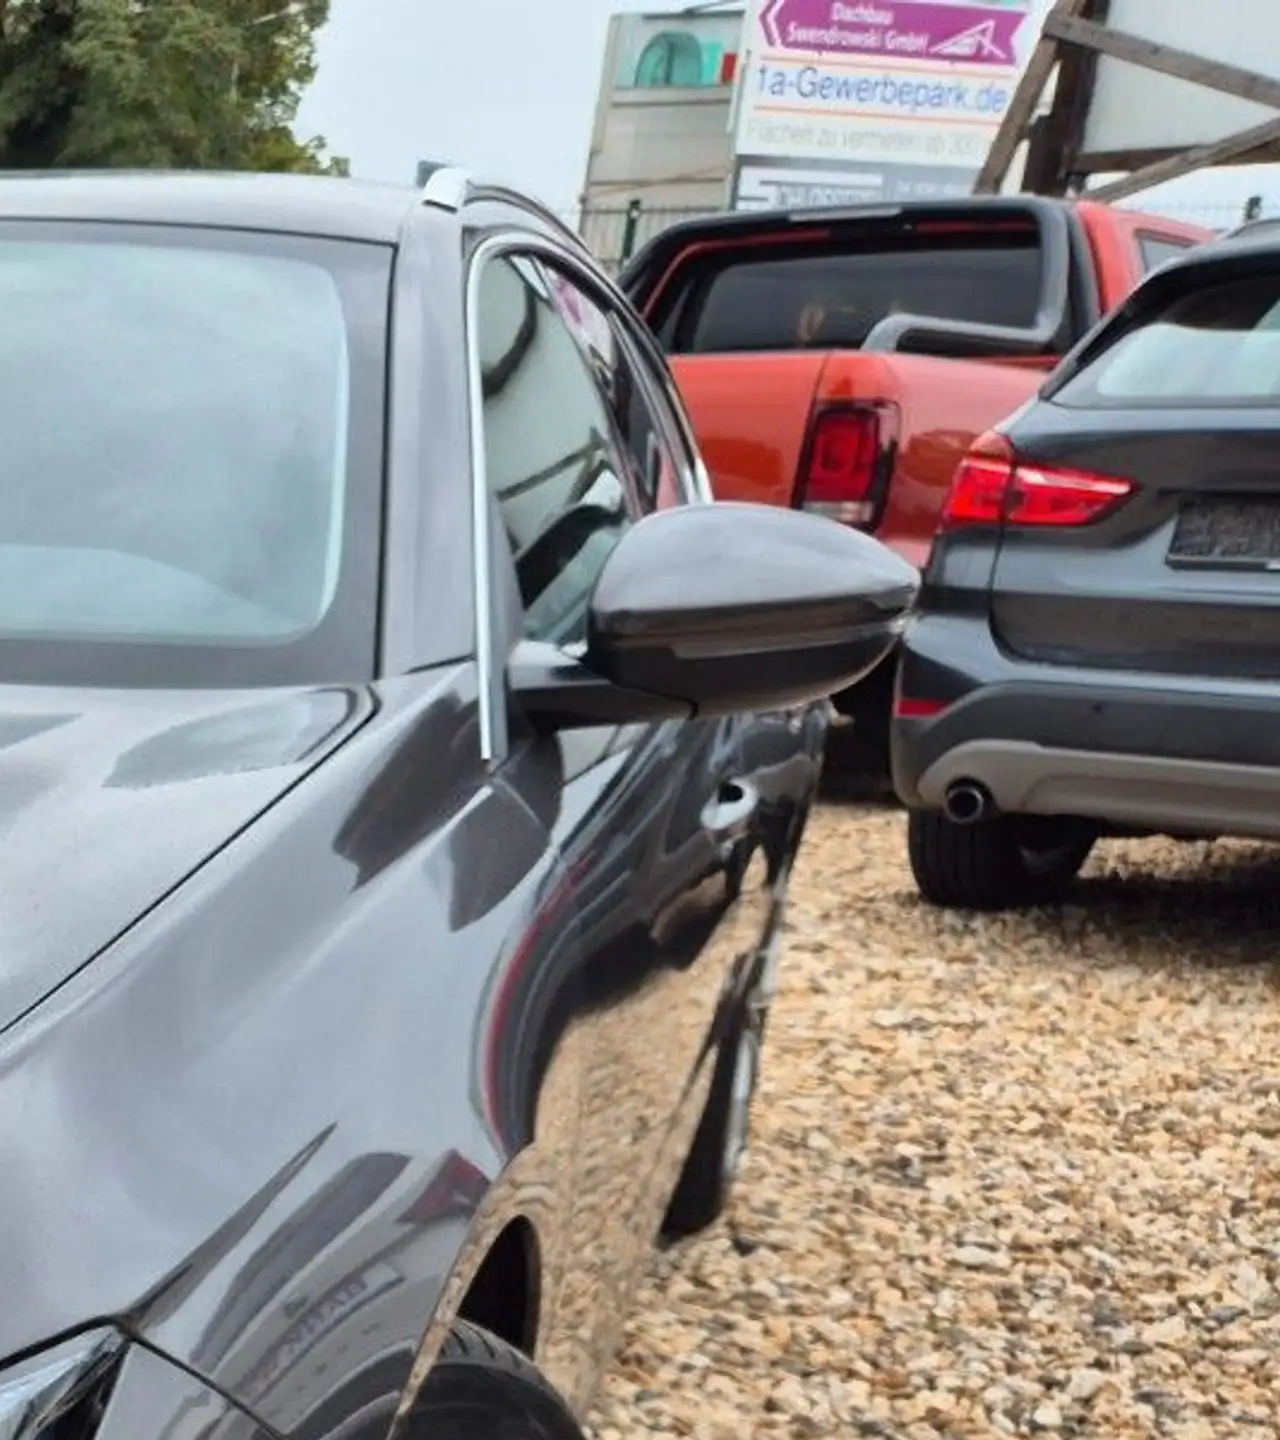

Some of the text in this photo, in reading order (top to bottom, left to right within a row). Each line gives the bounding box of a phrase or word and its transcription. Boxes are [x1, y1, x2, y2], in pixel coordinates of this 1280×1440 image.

[831, 2, 895, 25] Dachbau
[884, 30, 929, 51] GmbH
[757, 66, 1008, 113] 1a-Gewerbepark.de
